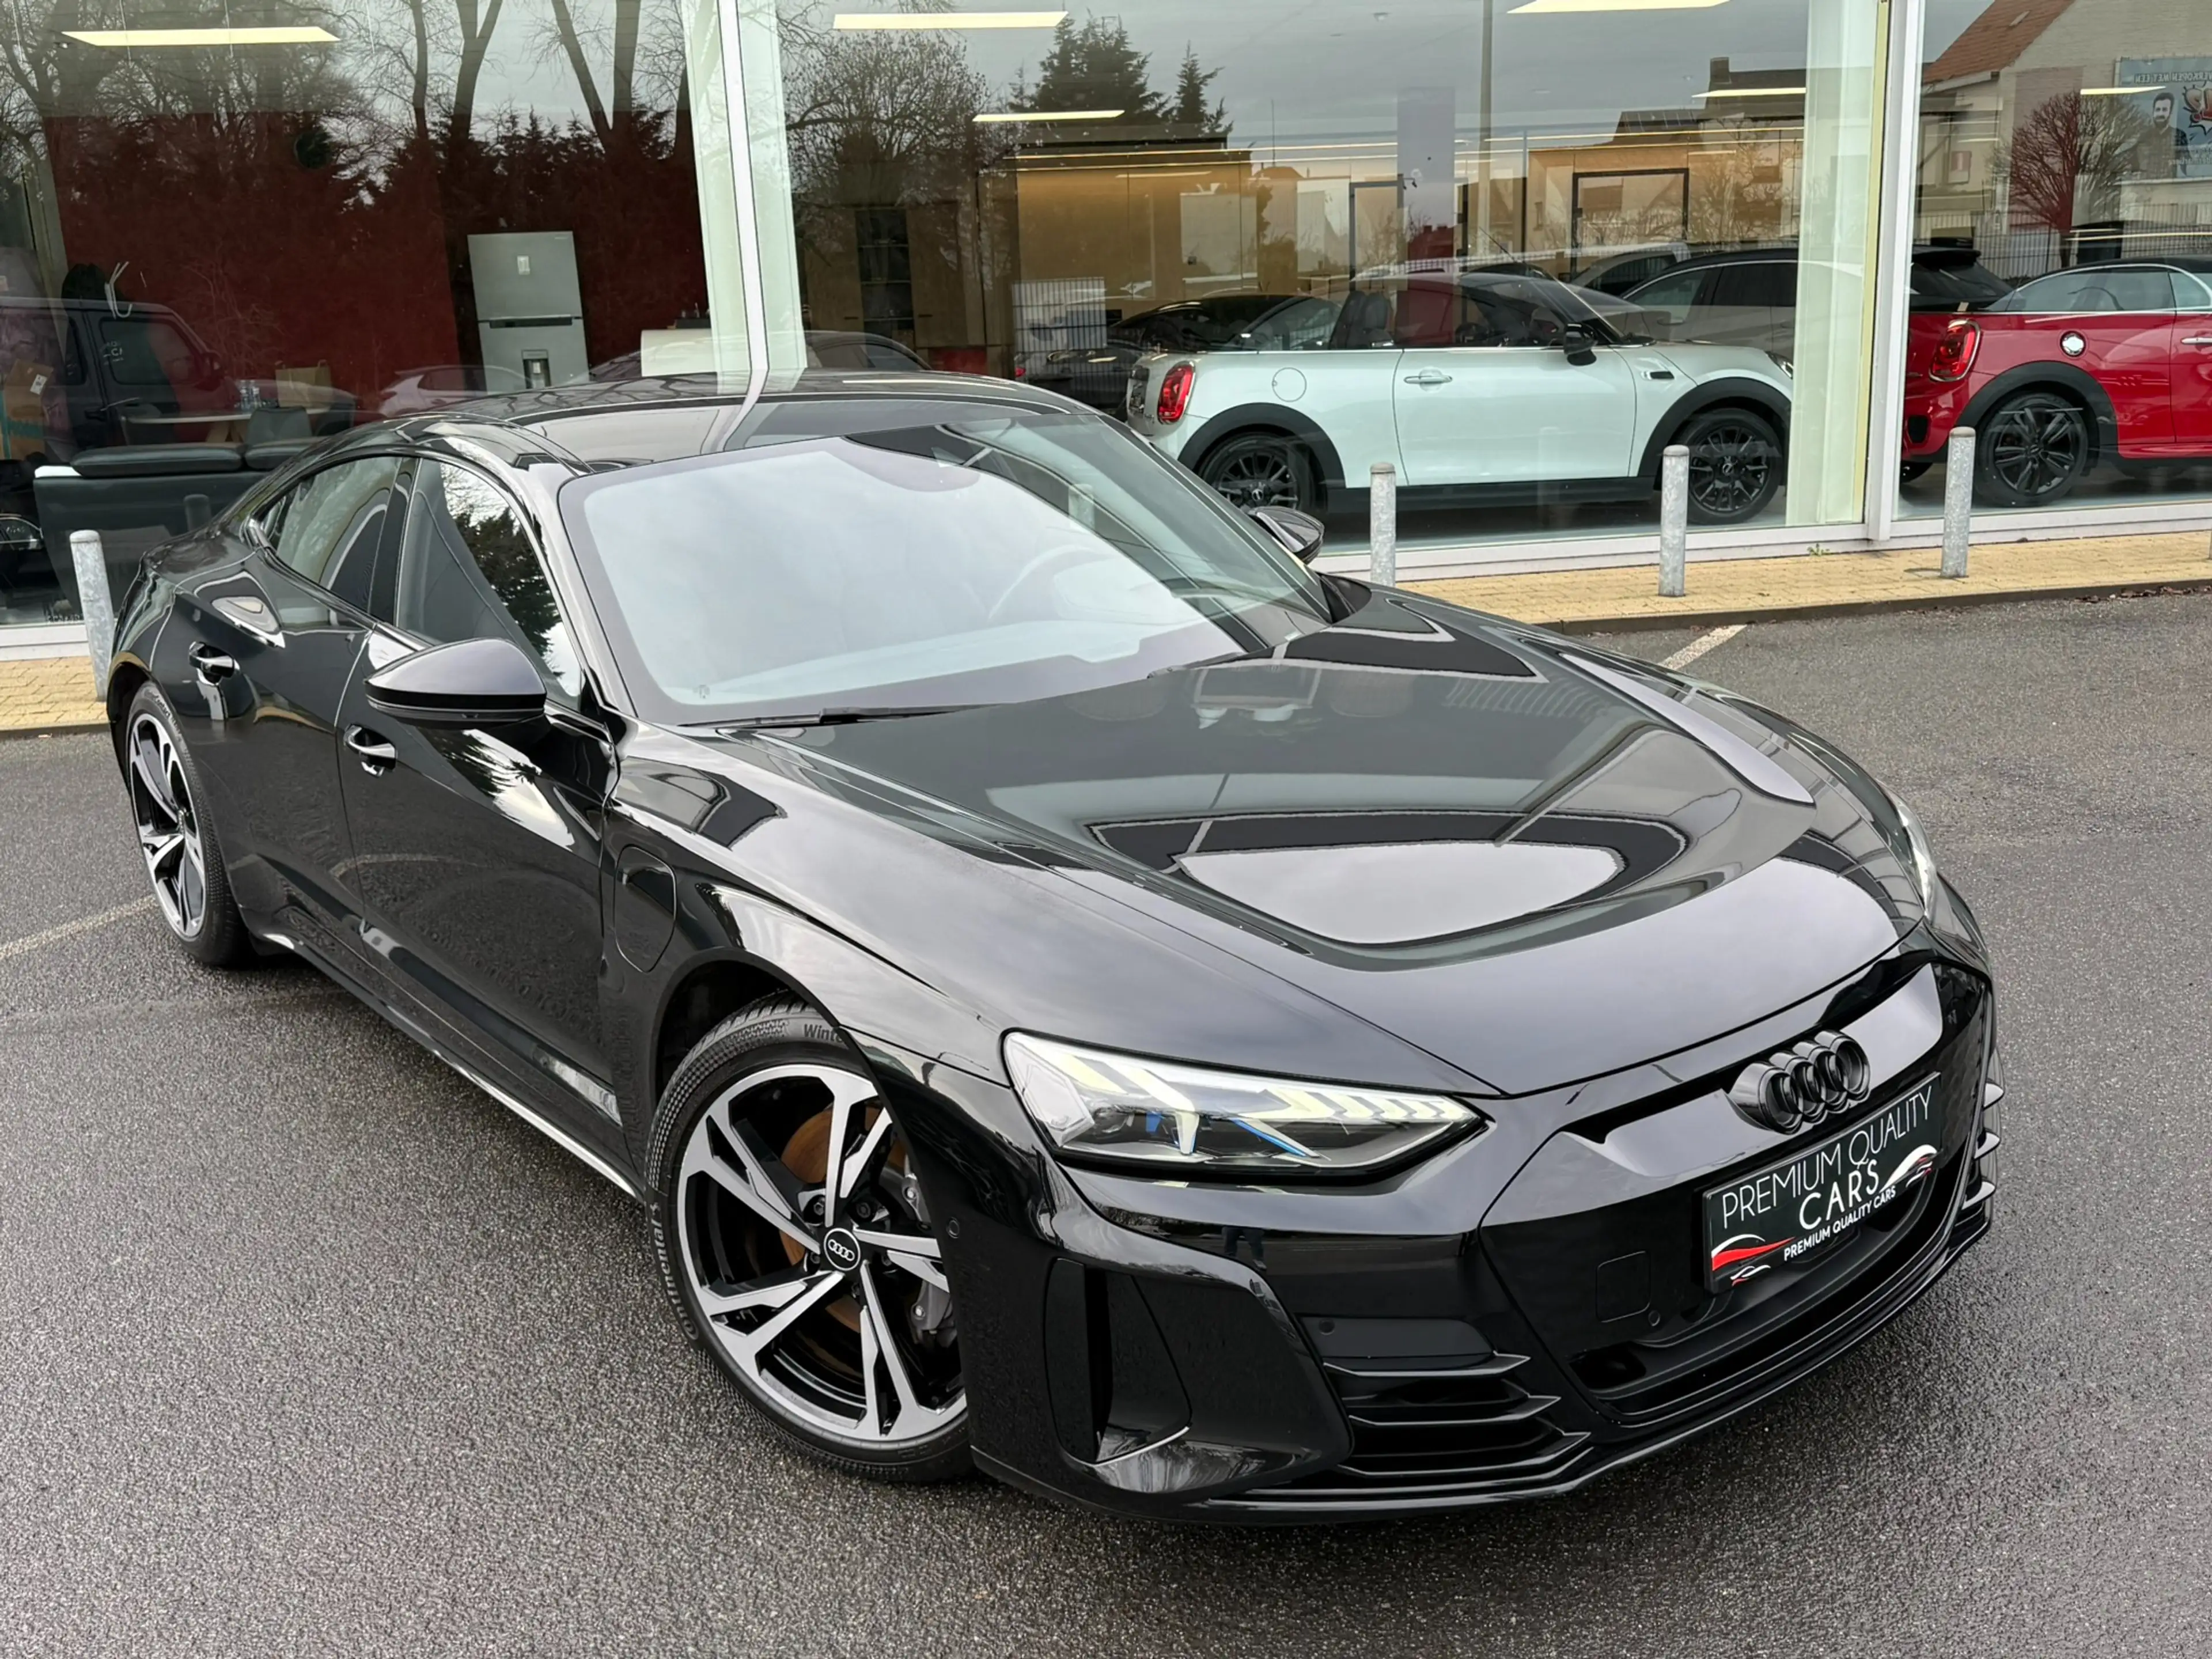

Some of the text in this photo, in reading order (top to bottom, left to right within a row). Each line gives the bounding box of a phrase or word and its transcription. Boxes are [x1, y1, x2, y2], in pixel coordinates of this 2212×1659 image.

[1722, 1085, 1933, 1229] PREMIUM QUALITY
[1799, 1158, 1880, 1230] CARS
[1783, 1185, 1896, 1261] PREMIUM QUALITY CARS
[652, 1218, 699, 1340] Continental
